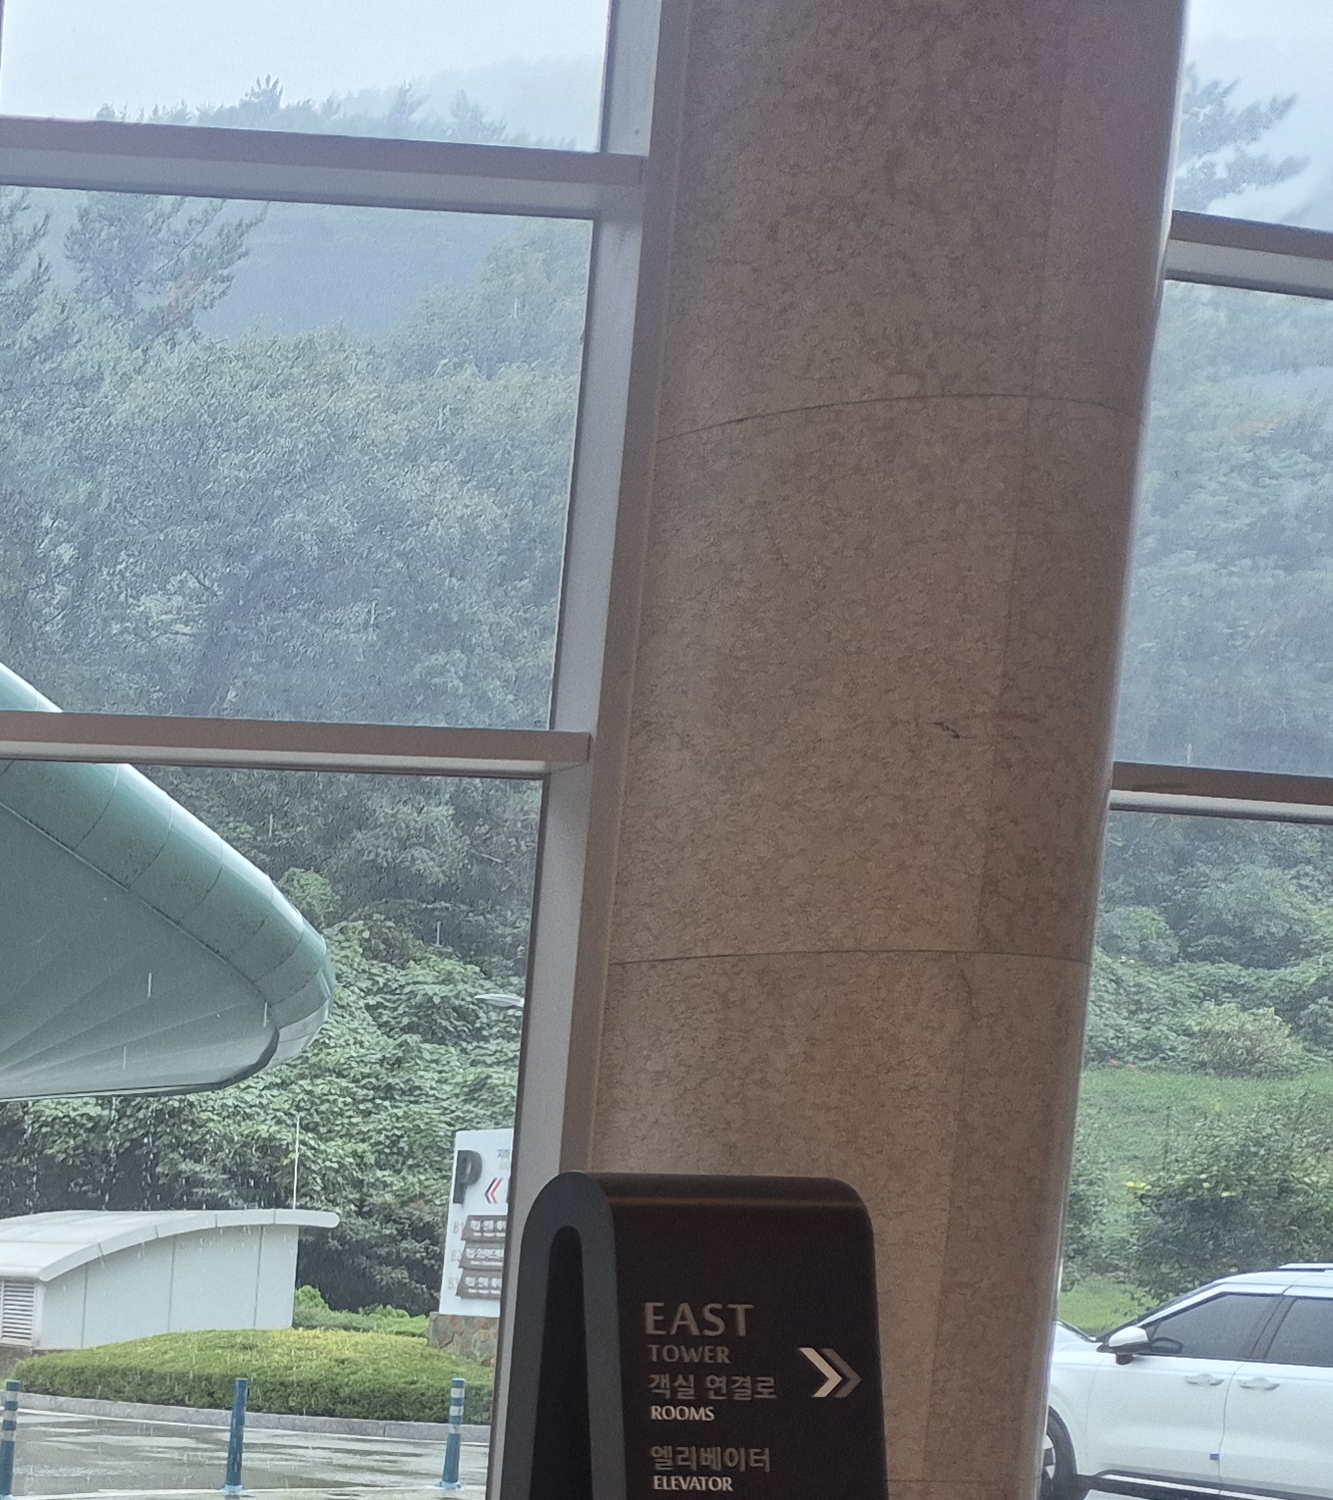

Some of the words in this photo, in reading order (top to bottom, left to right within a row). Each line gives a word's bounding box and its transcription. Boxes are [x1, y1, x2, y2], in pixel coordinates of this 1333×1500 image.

[453, 1150, 483, 1205] P
[643, 1301, 754, 1337] EAST
[648, 1344, 730, 1365] TOWER
[648, 1374, 696, 1401] 객실
[705, 1375, 778, 1401] 연결로
[651, 1405, 715, 1422] ROOMS
[650, 1445, 771, 1473] 엘리베이터
[653, 1475, 733, 1492] ELEVATOR
